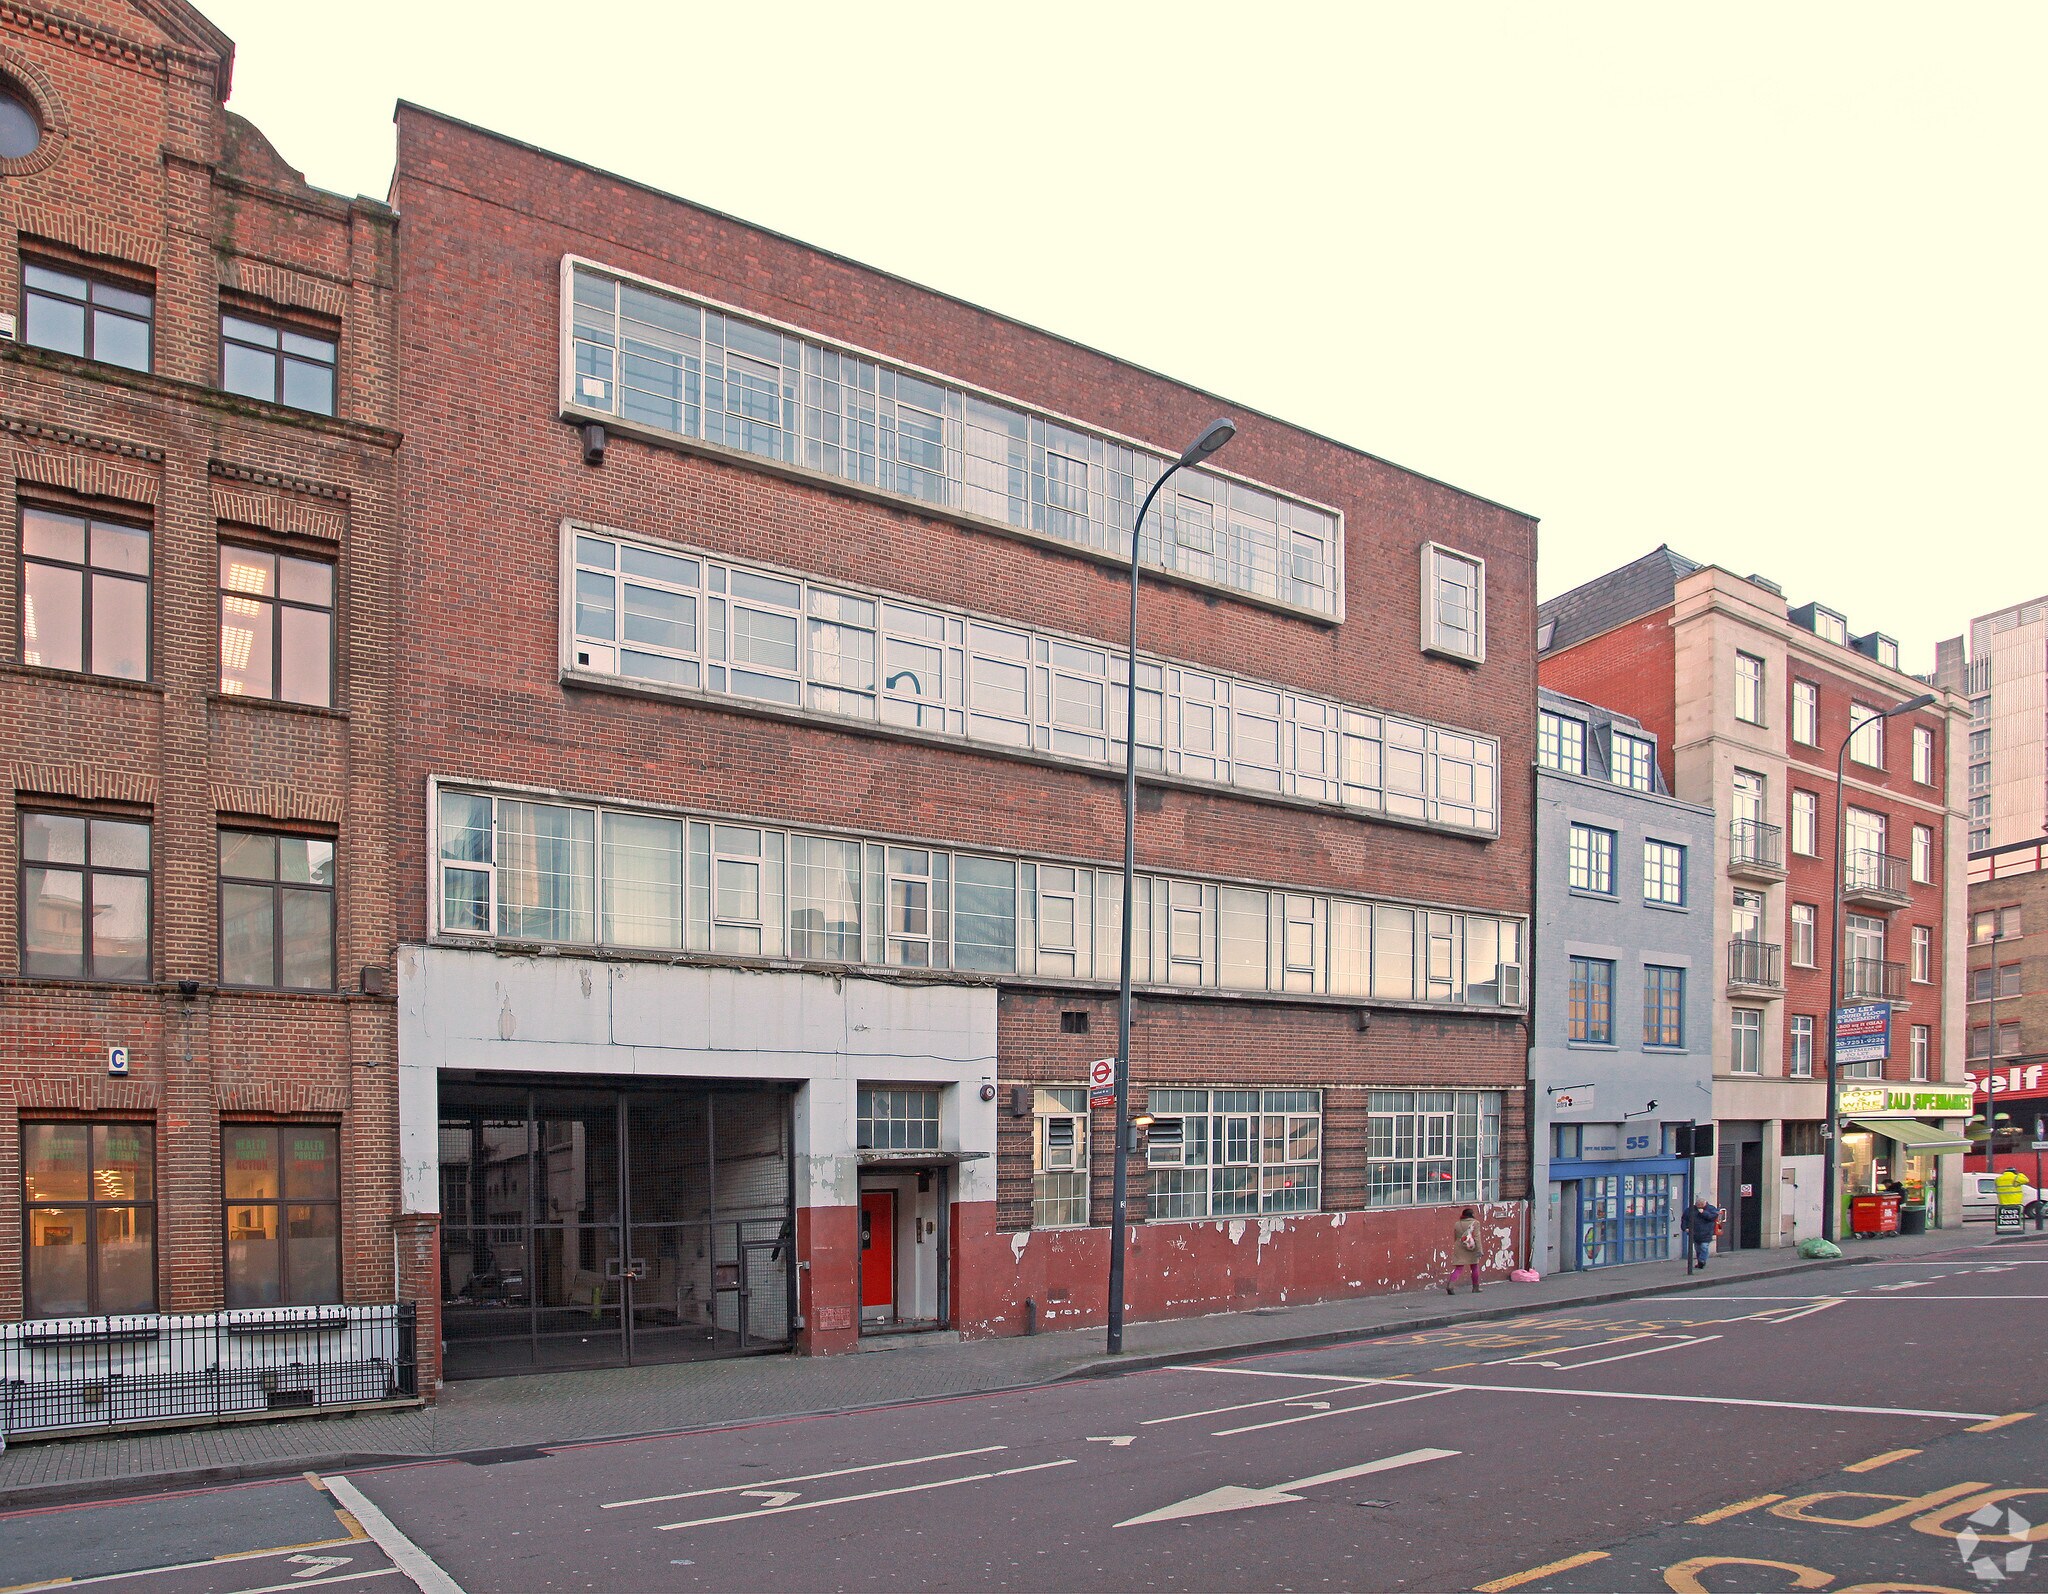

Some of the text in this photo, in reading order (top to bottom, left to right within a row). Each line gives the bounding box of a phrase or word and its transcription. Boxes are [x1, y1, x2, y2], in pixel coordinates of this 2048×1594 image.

[112, 1049, 125, 1068] C
[294, 1140, 325, 1151] HEALTH
[1626, 1136, 1649, 1149] 55
[1372, 1333, 1565, 1348] BUS
